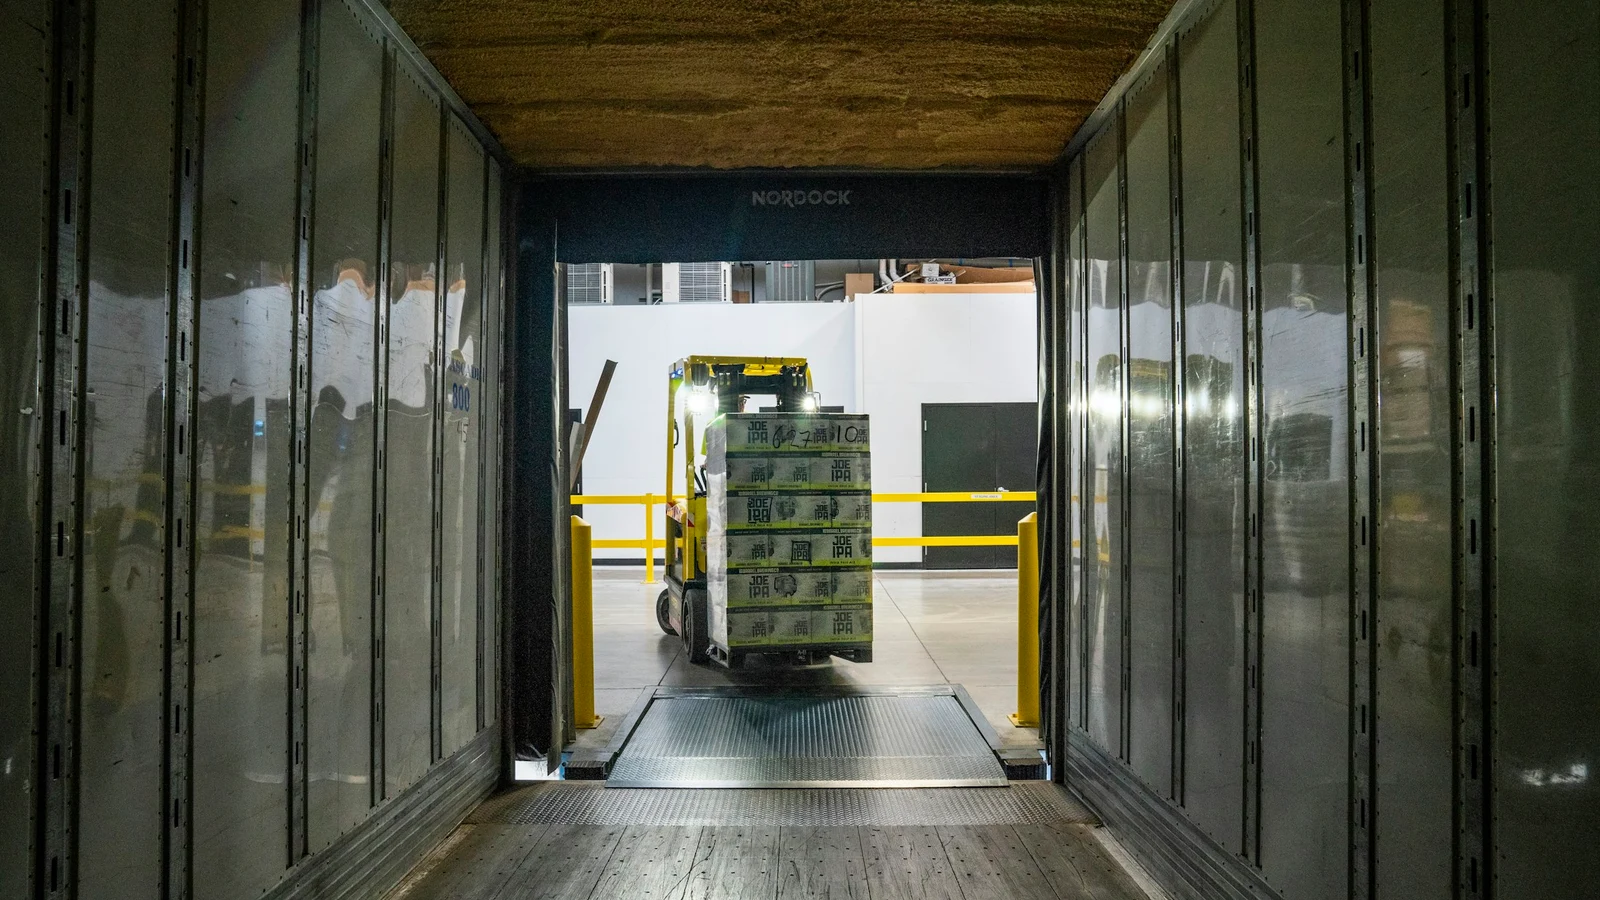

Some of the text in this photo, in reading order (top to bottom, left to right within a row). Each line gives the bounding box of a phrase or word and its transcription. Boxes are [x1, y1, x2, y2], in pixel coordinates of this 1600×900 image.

[752, 190, 850, 208] NORDOCK
[453, 383, 470, 412] 800
[748, 421, 767, 431] JOE
[748, 432, 768, 443] IPA
[837, 425, 859, 442] 10
[813, 434, 827, 443] IPA
[831, 460, 851, 469] JOE
[751, 474, 765, 482] IPA
[793, 474, 807, 482] IPA
[831, 470, 851, 481] IPA
[815, 512, 828, 520] IPA
[856, 512, 869, 520] IPA
[833, 536, 852, 545] JOE
[752, 552, 765, 560] IPA
[793, 551, 807, 560] IPA
[833, 546, 852, 558] IPA
[749, 576, 769, 585] JOE
[749, 586, 769, 598] IPA
[815, 589, 828, 597] IPA
[856, 588, 869, 596] IPA
[833, 612, 853, 621] JOE
[794, 628, 807, 636] IPA
[833, 622, 853, 634] IPA
[752, 629, 766, 637] IPA
